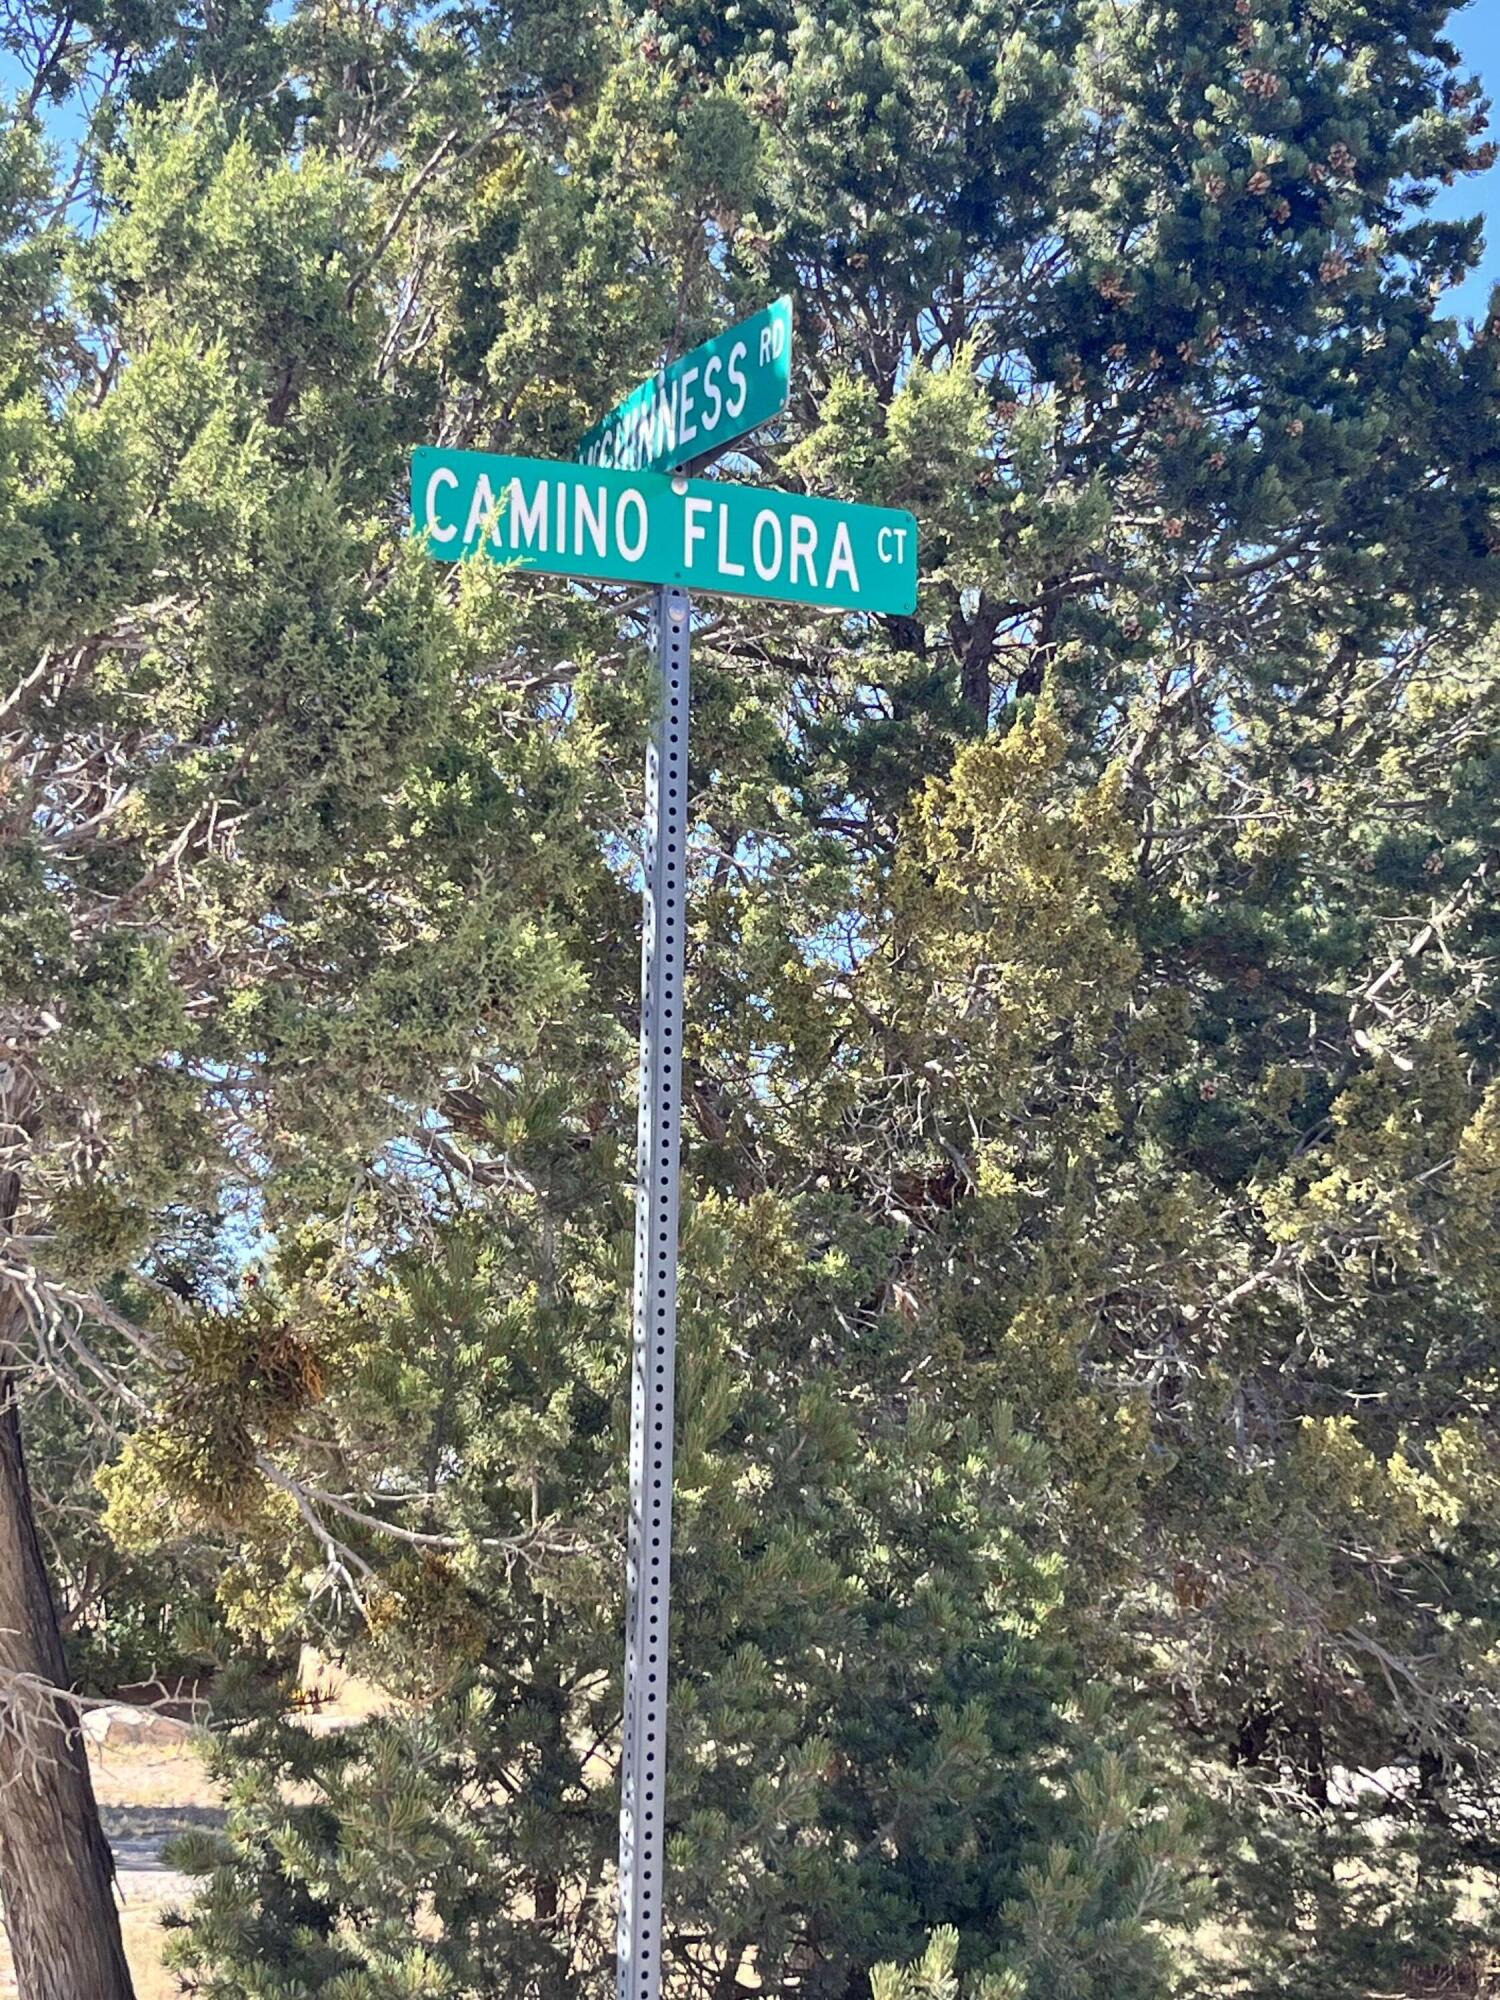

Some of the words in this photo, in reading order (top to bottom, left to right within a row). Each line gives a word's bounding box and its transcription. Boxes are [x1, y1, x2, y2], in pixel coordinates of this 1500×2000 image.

[759, 318, 785, 367] RD
[425, 467, 649, 563] CAMINO
[684, 496, 861, 592] FLORA
[877, 529, 907, 565] CT
